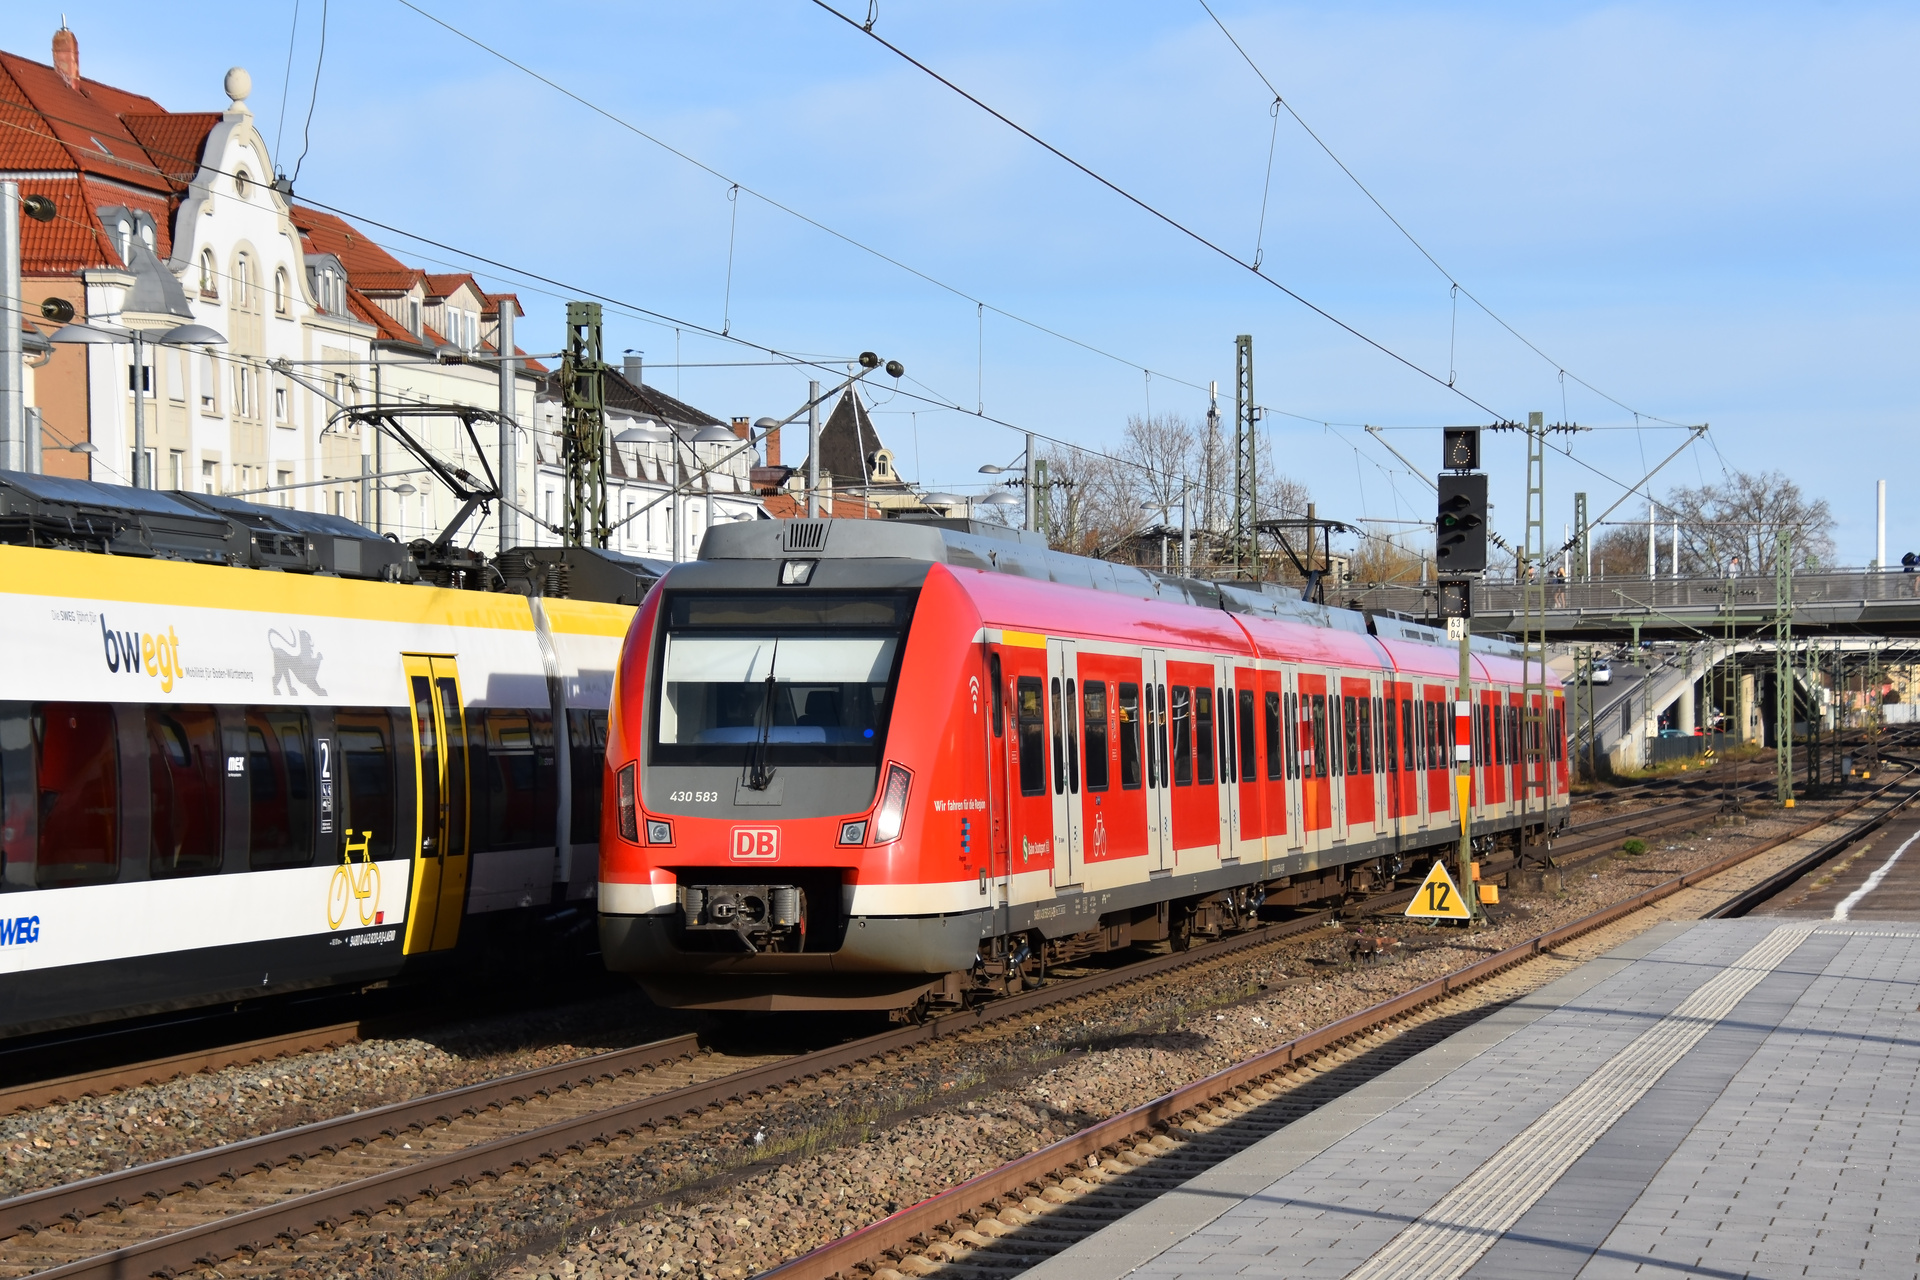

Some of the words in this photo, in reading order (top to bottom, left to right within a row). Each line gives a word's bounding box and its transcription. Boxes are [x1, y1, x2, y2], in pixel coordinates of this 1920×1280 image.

[1453, 431, 1470, 464] 6
[60, 610, 76, 621] SWEG
[1450, 619, 1461, 628] 63
[1450, 629, 1461, 639] 04
[100, 612, 184, 694] bwegt
[1110, 684, 1115, 714] 2
[321, 742, 330, 778] 2
[669, 791, 693, 802] 430
[695, 791, 718, 802] 583
[934, 800, 947, 812] Wir
[947, 799, 963, 811] fahren
[974, 799, 986, 812] Region
[736, 831, 775, 856] DB
[1425, 881, 1451, 912] 12
